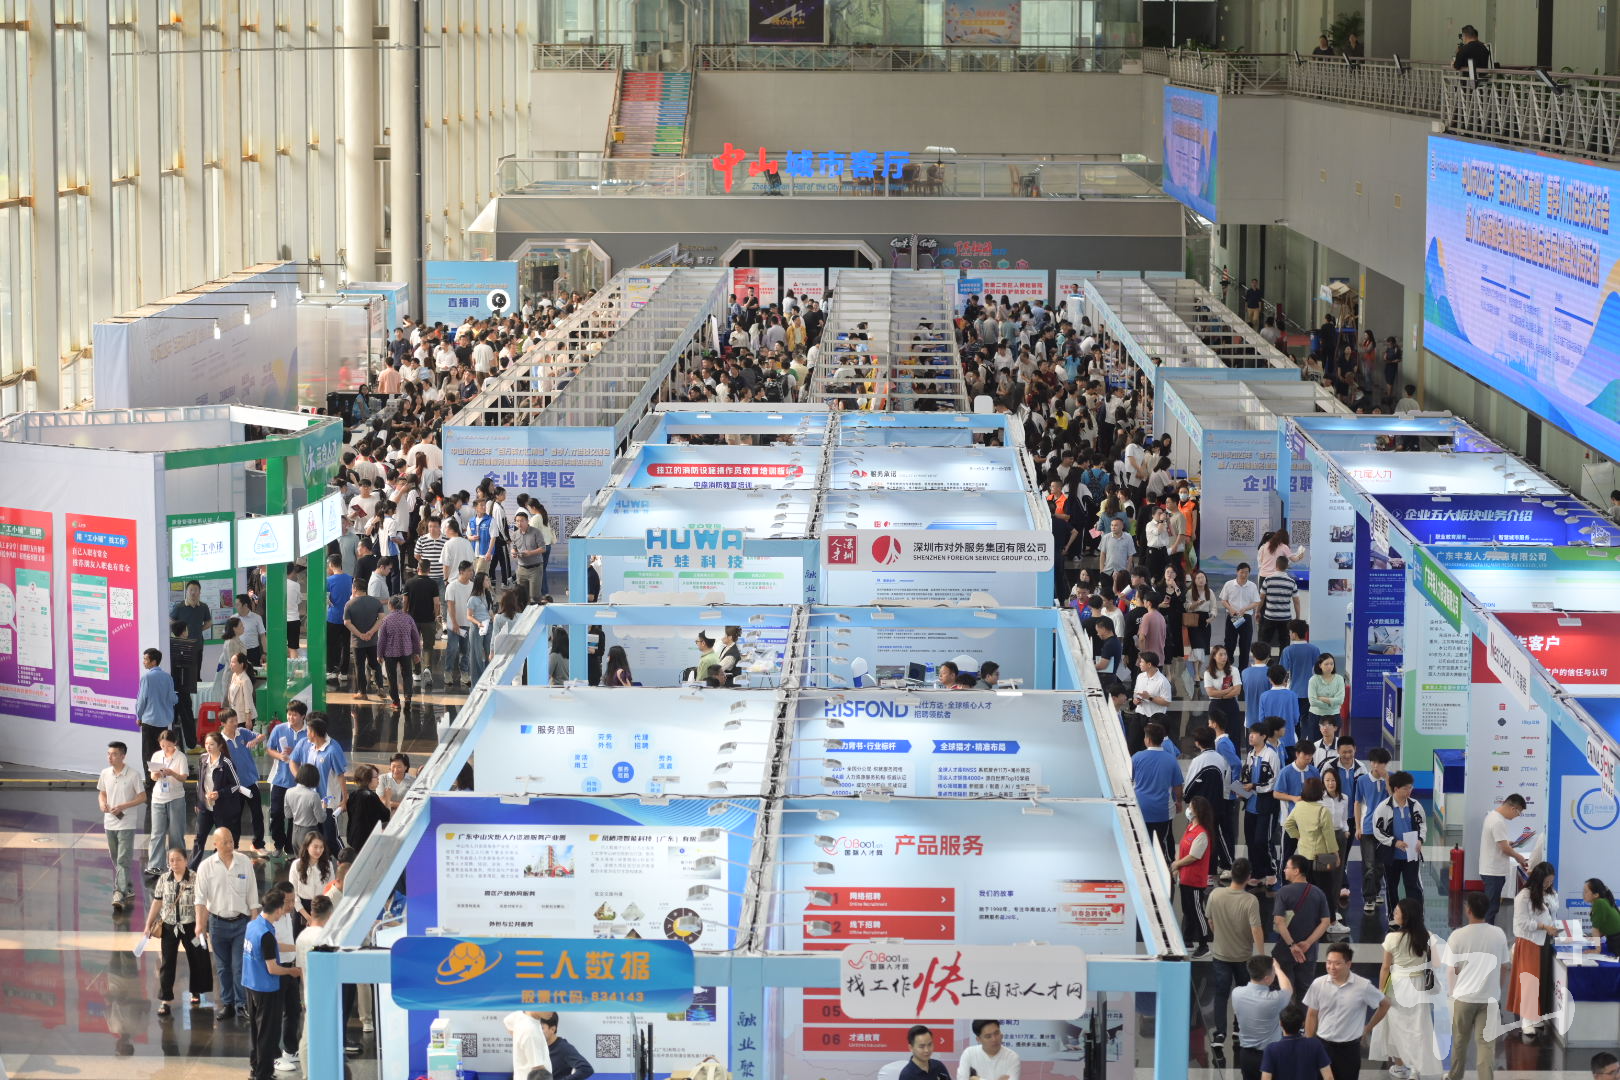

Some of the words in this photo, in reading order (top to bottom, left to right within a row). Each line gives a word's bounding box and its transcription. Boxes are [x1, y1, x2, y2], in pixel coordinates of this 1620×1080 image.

[713, 143, 910, 193] 中山城市客厅
[448, 297, 480, 308] 直播间
[484, 471, 576, 488] 企业招聘区
[871, 470, 897, 478] 服务承诺
[1353, 470, 1392, 479] 九尾人力
[1404, 509, 1533, 521] 企业五大板块业务介绍
[646, 529, 743, 550] HUWA
[913, 542, 1047, 553] 深圳市对外服务集团有限公司
[648, 555, 743, 569] 虎蛙科技
[825, 701, 908, 718] RISFOND
[914, 711, 951, 719] 招聘领航者
[537, 725, 575, 735] 服务范围
[840, 742, 896, 751] 力背书·行业标杆
[894, 835, 984, 856] 产品服务
[849, 892, 881, 900] 网络招聘
[515, 950, 650, 980] 三人数据
[847, 951, 1083, 1017] 找工作快上国际人才网
[822, 1005, 841, 1017] 05
[822, 1034, 841, 1045] 06
